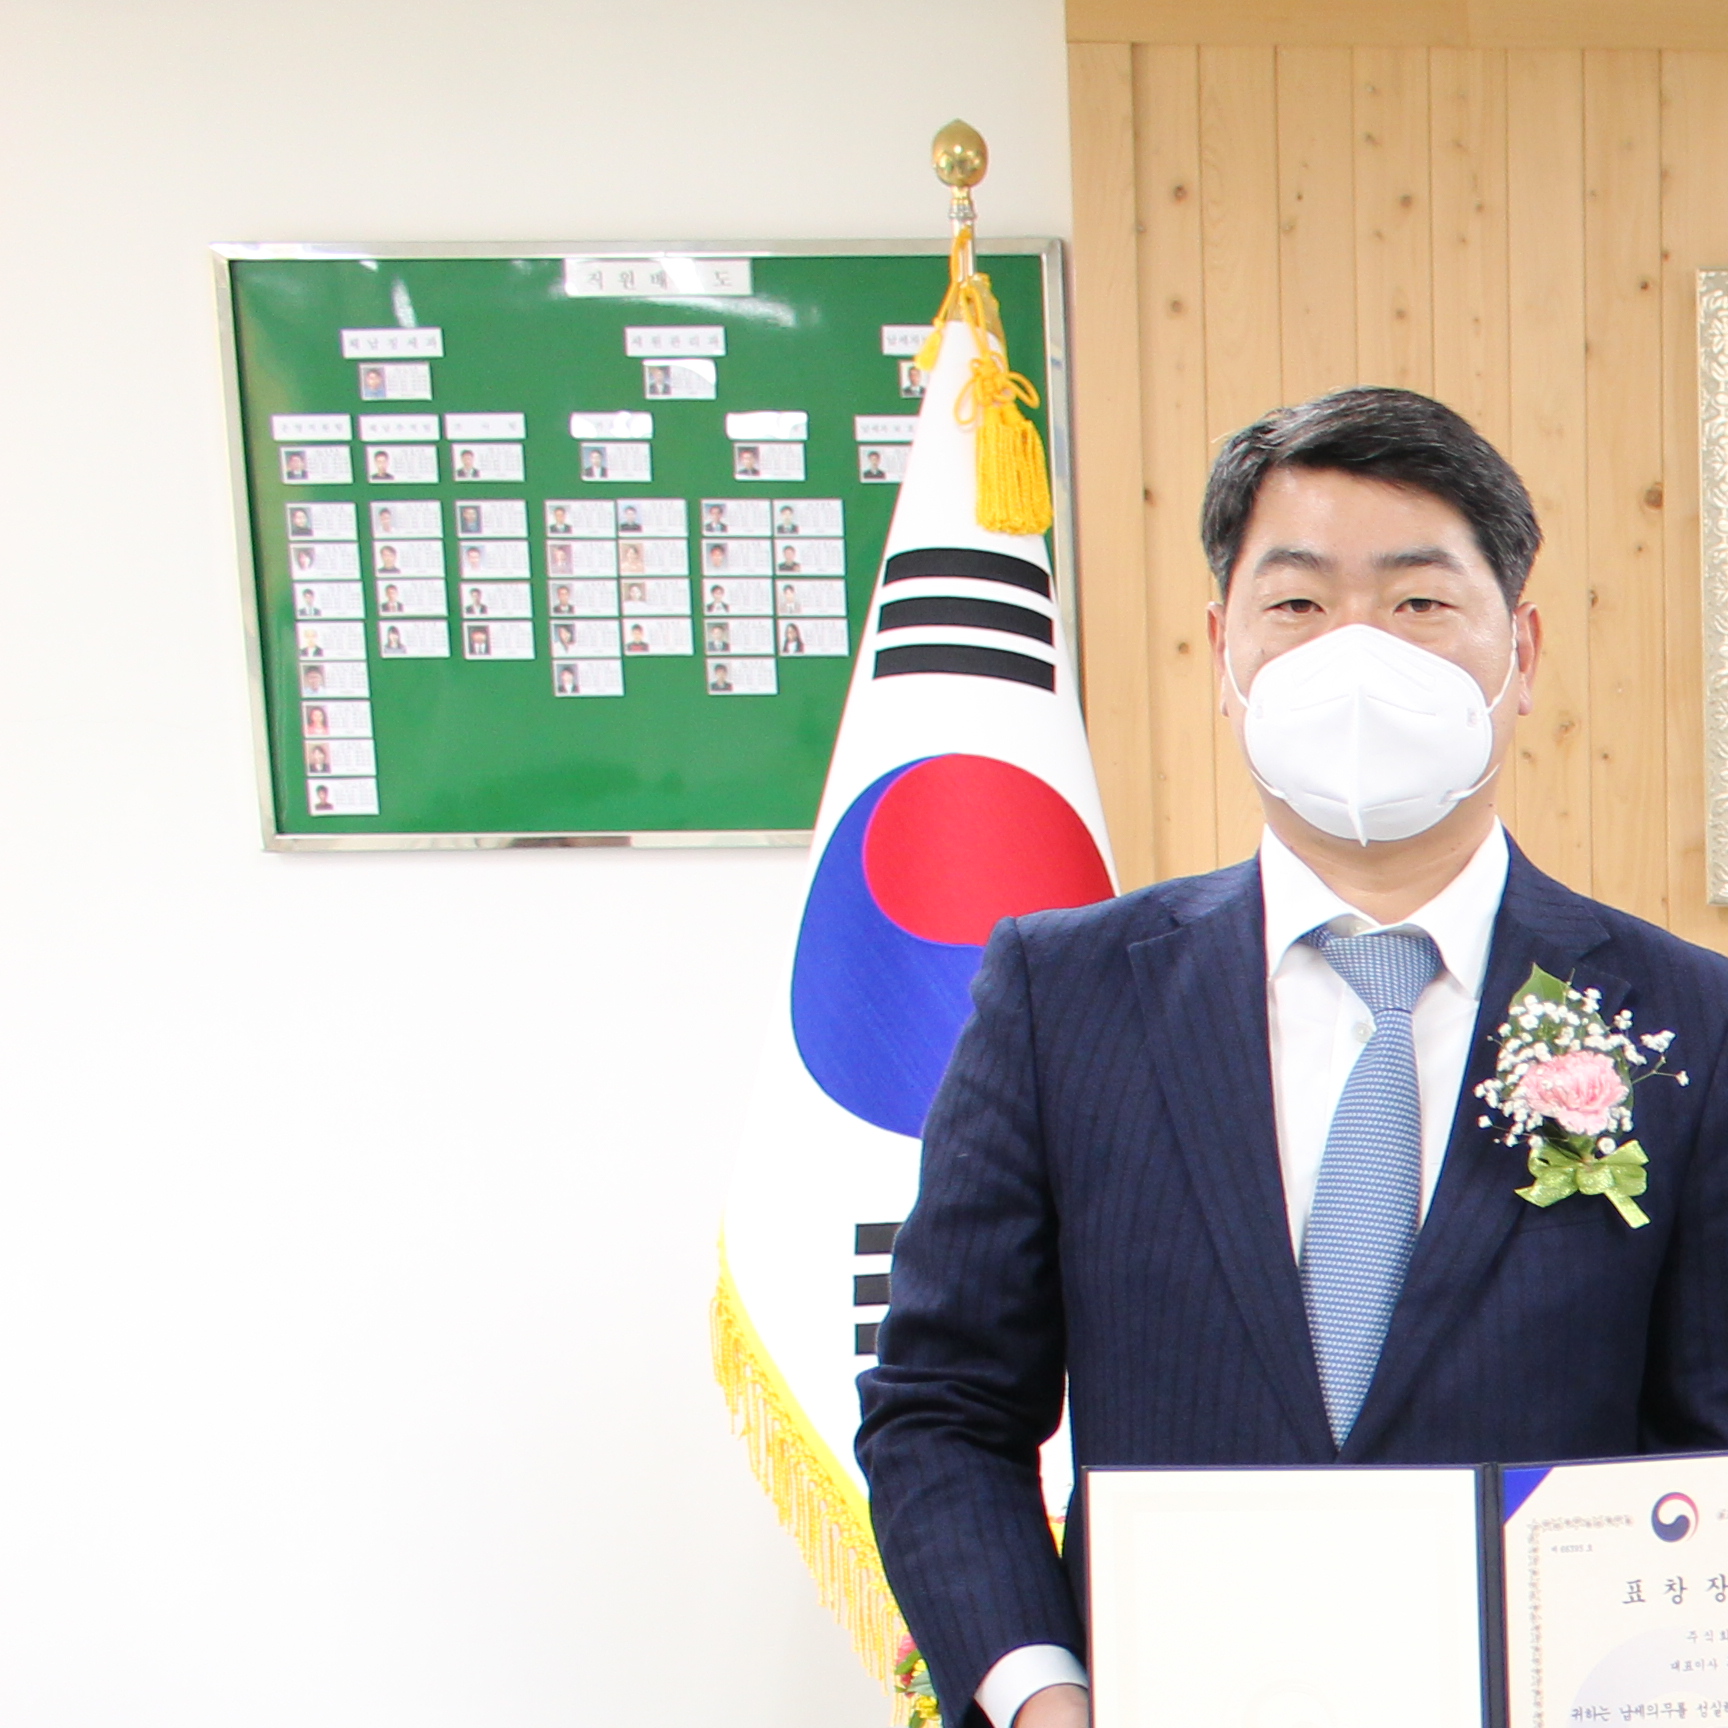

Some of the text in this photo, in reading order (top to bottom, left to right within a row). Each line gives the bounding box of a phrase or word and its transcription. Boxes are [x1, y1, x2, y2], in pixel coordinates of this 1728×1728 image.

[588, 270, 732, 290] 직원배도
[1670, 1657, 1718, 1672] 대표이사
[1571, 1705, 1612, 1722] 귀하는
[1618, 1701, 1688, 1722] 납세의무를
